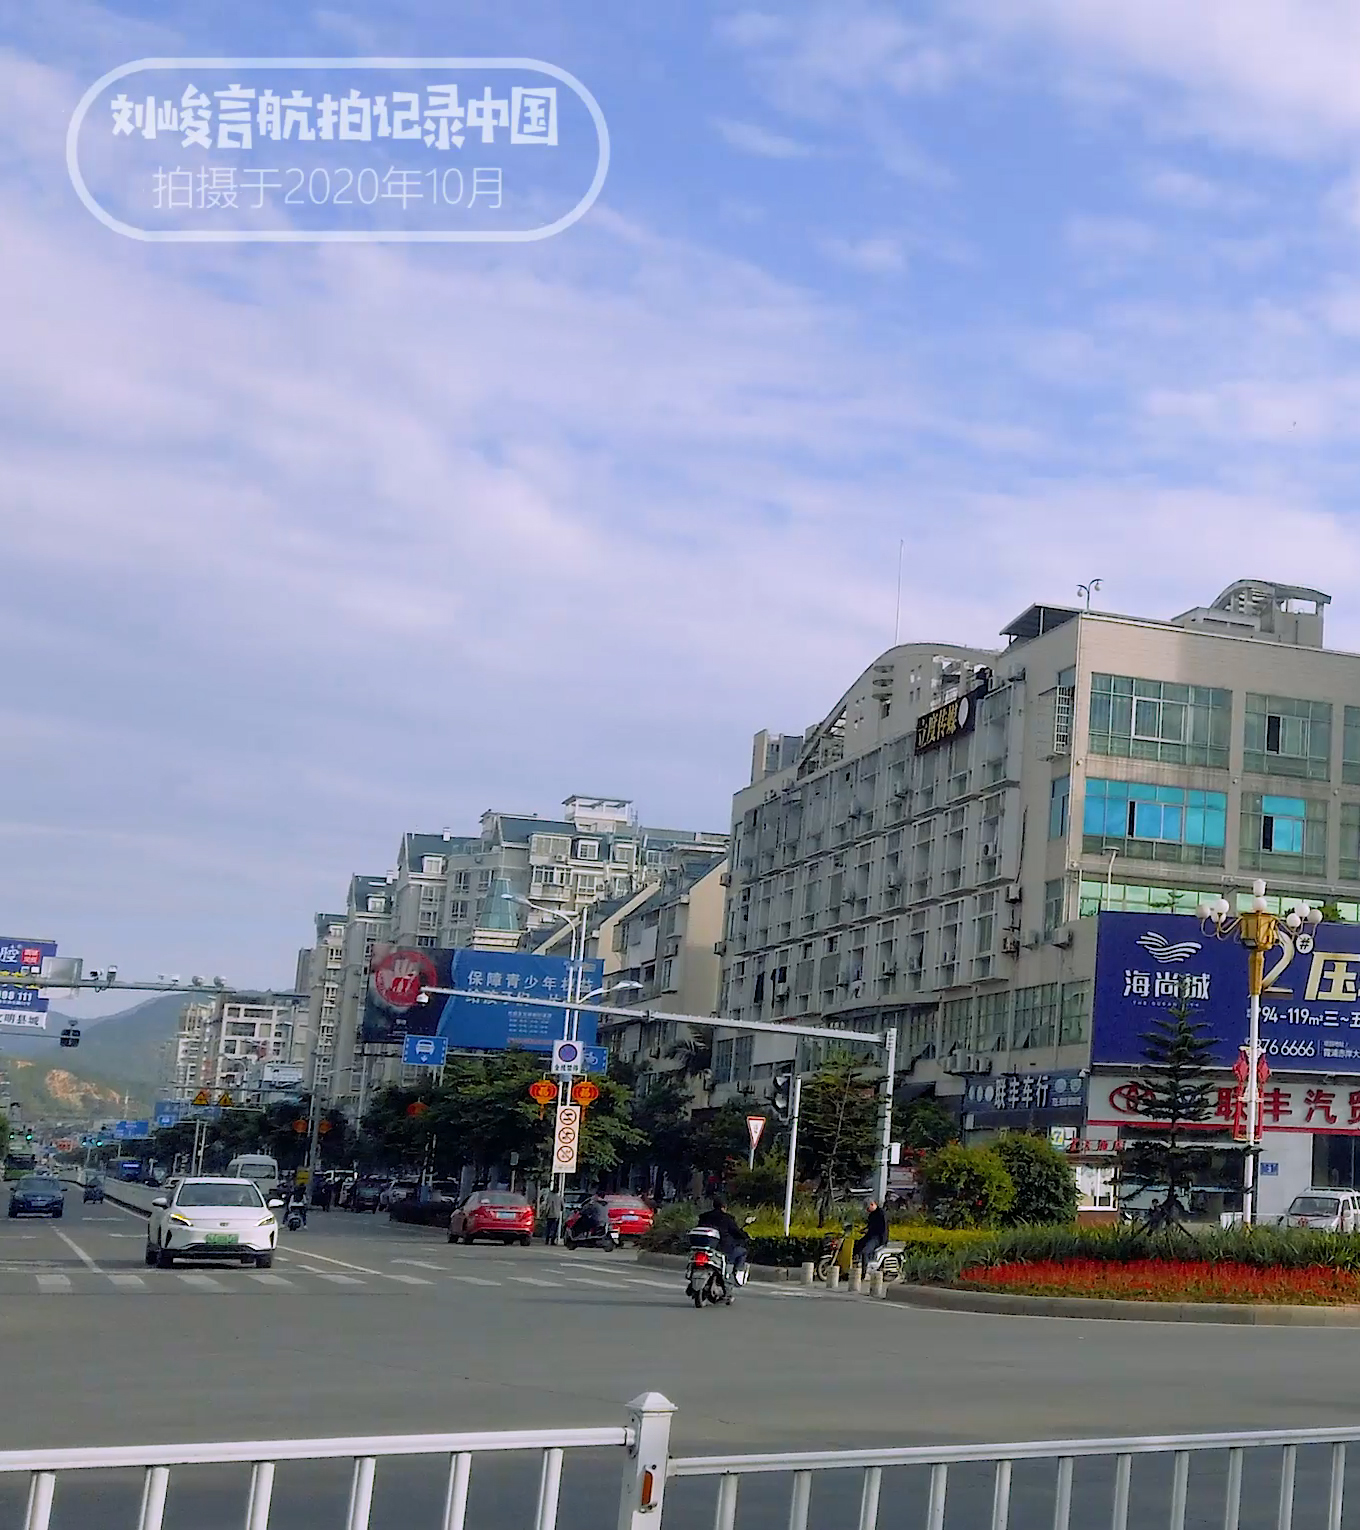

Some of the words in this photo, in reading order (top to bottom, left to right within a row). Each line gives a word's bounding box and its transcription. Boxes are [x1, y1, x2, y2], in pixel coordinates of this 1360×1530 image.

[1123, 969, 1211, 1000] 海尚城
[994, 1074, 1049, 1110] 联丰车行
